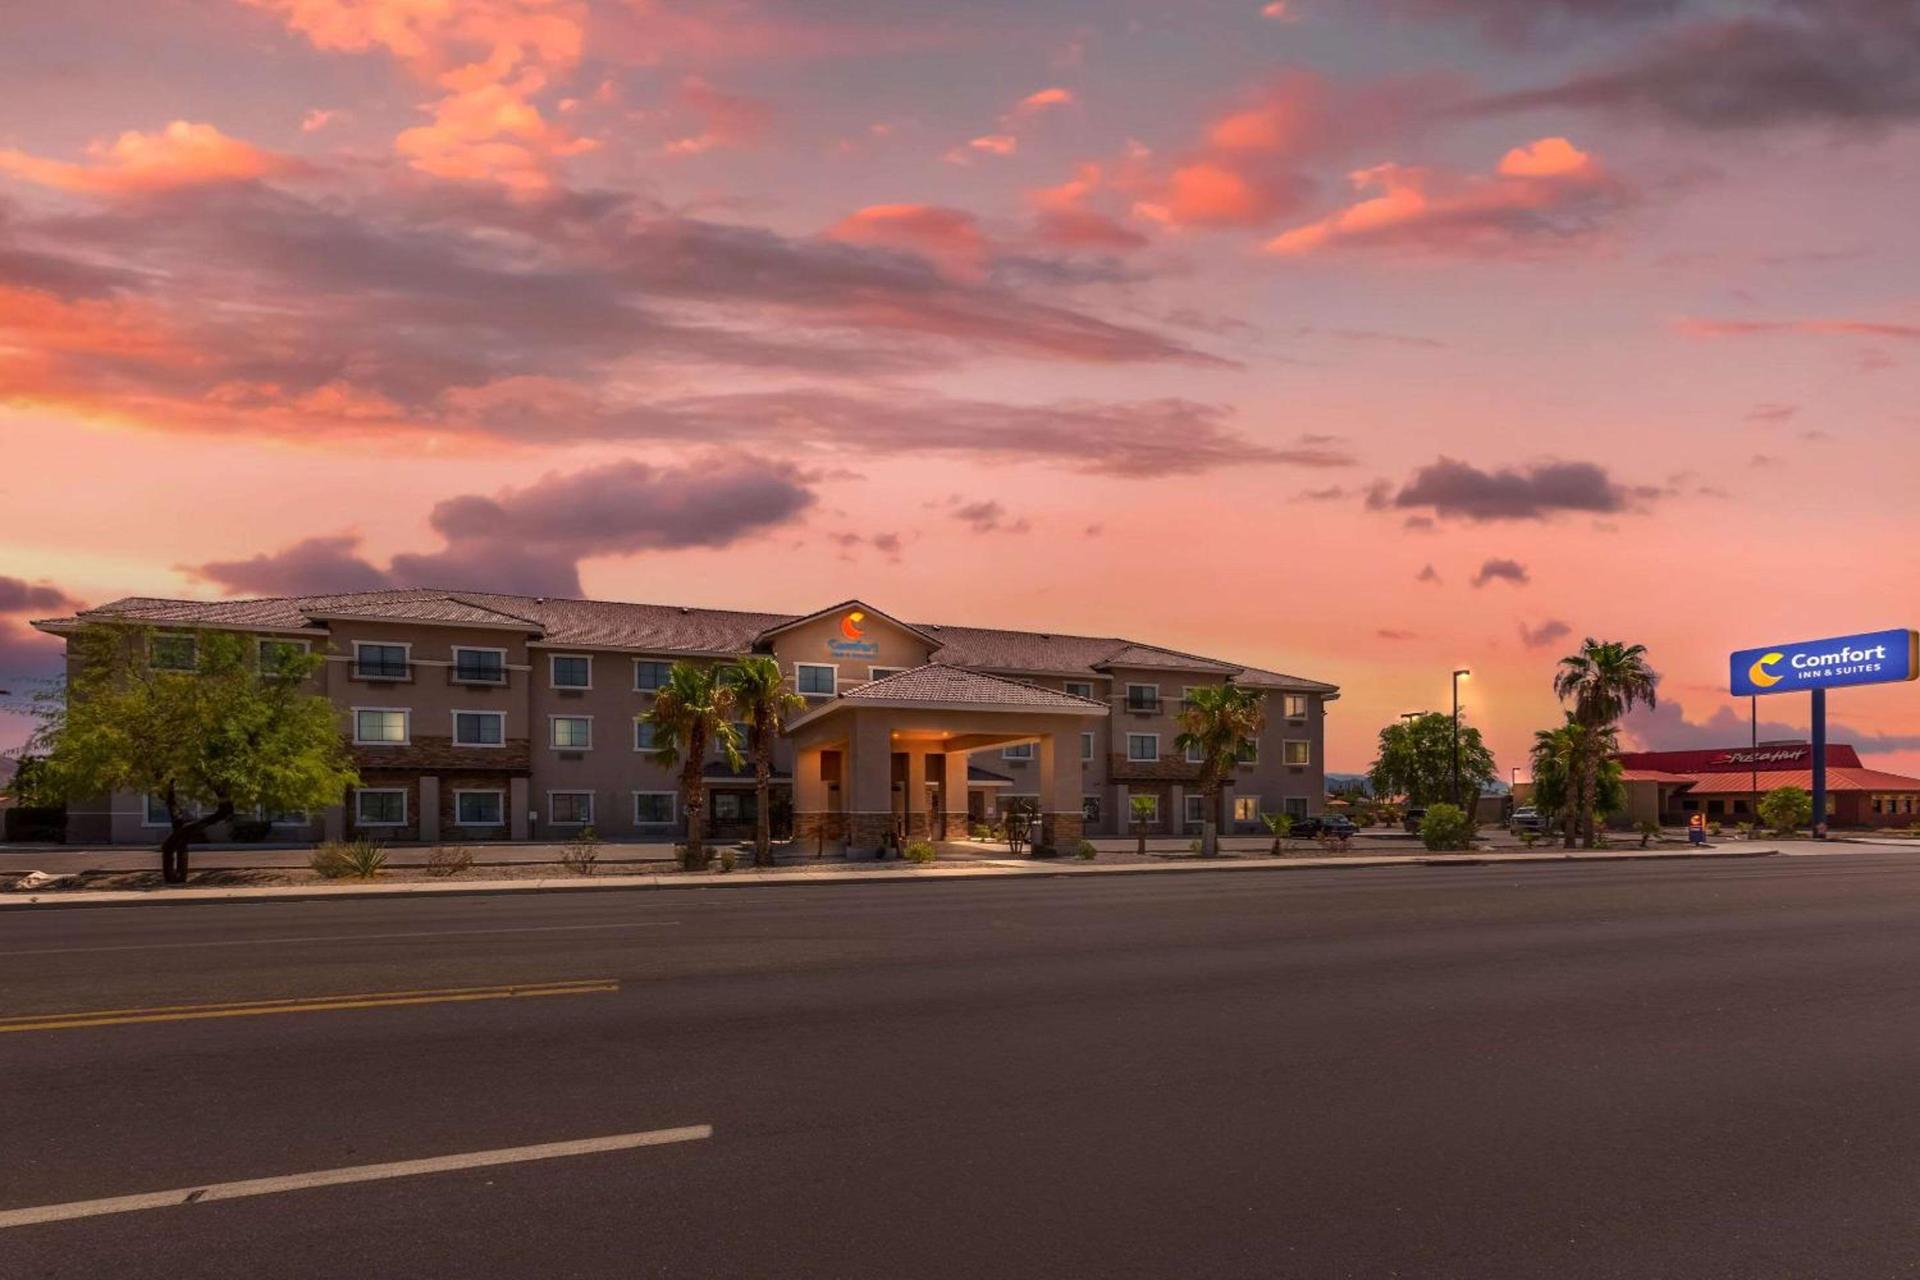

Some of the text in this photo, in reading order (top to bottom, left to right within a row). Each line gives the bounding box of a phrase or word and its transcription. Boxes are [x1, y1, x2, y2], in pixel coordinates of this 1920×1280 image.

[1791, 645, 1885, 669] Comfort
[1798, 663, 1881, 679] INN & SUITES
